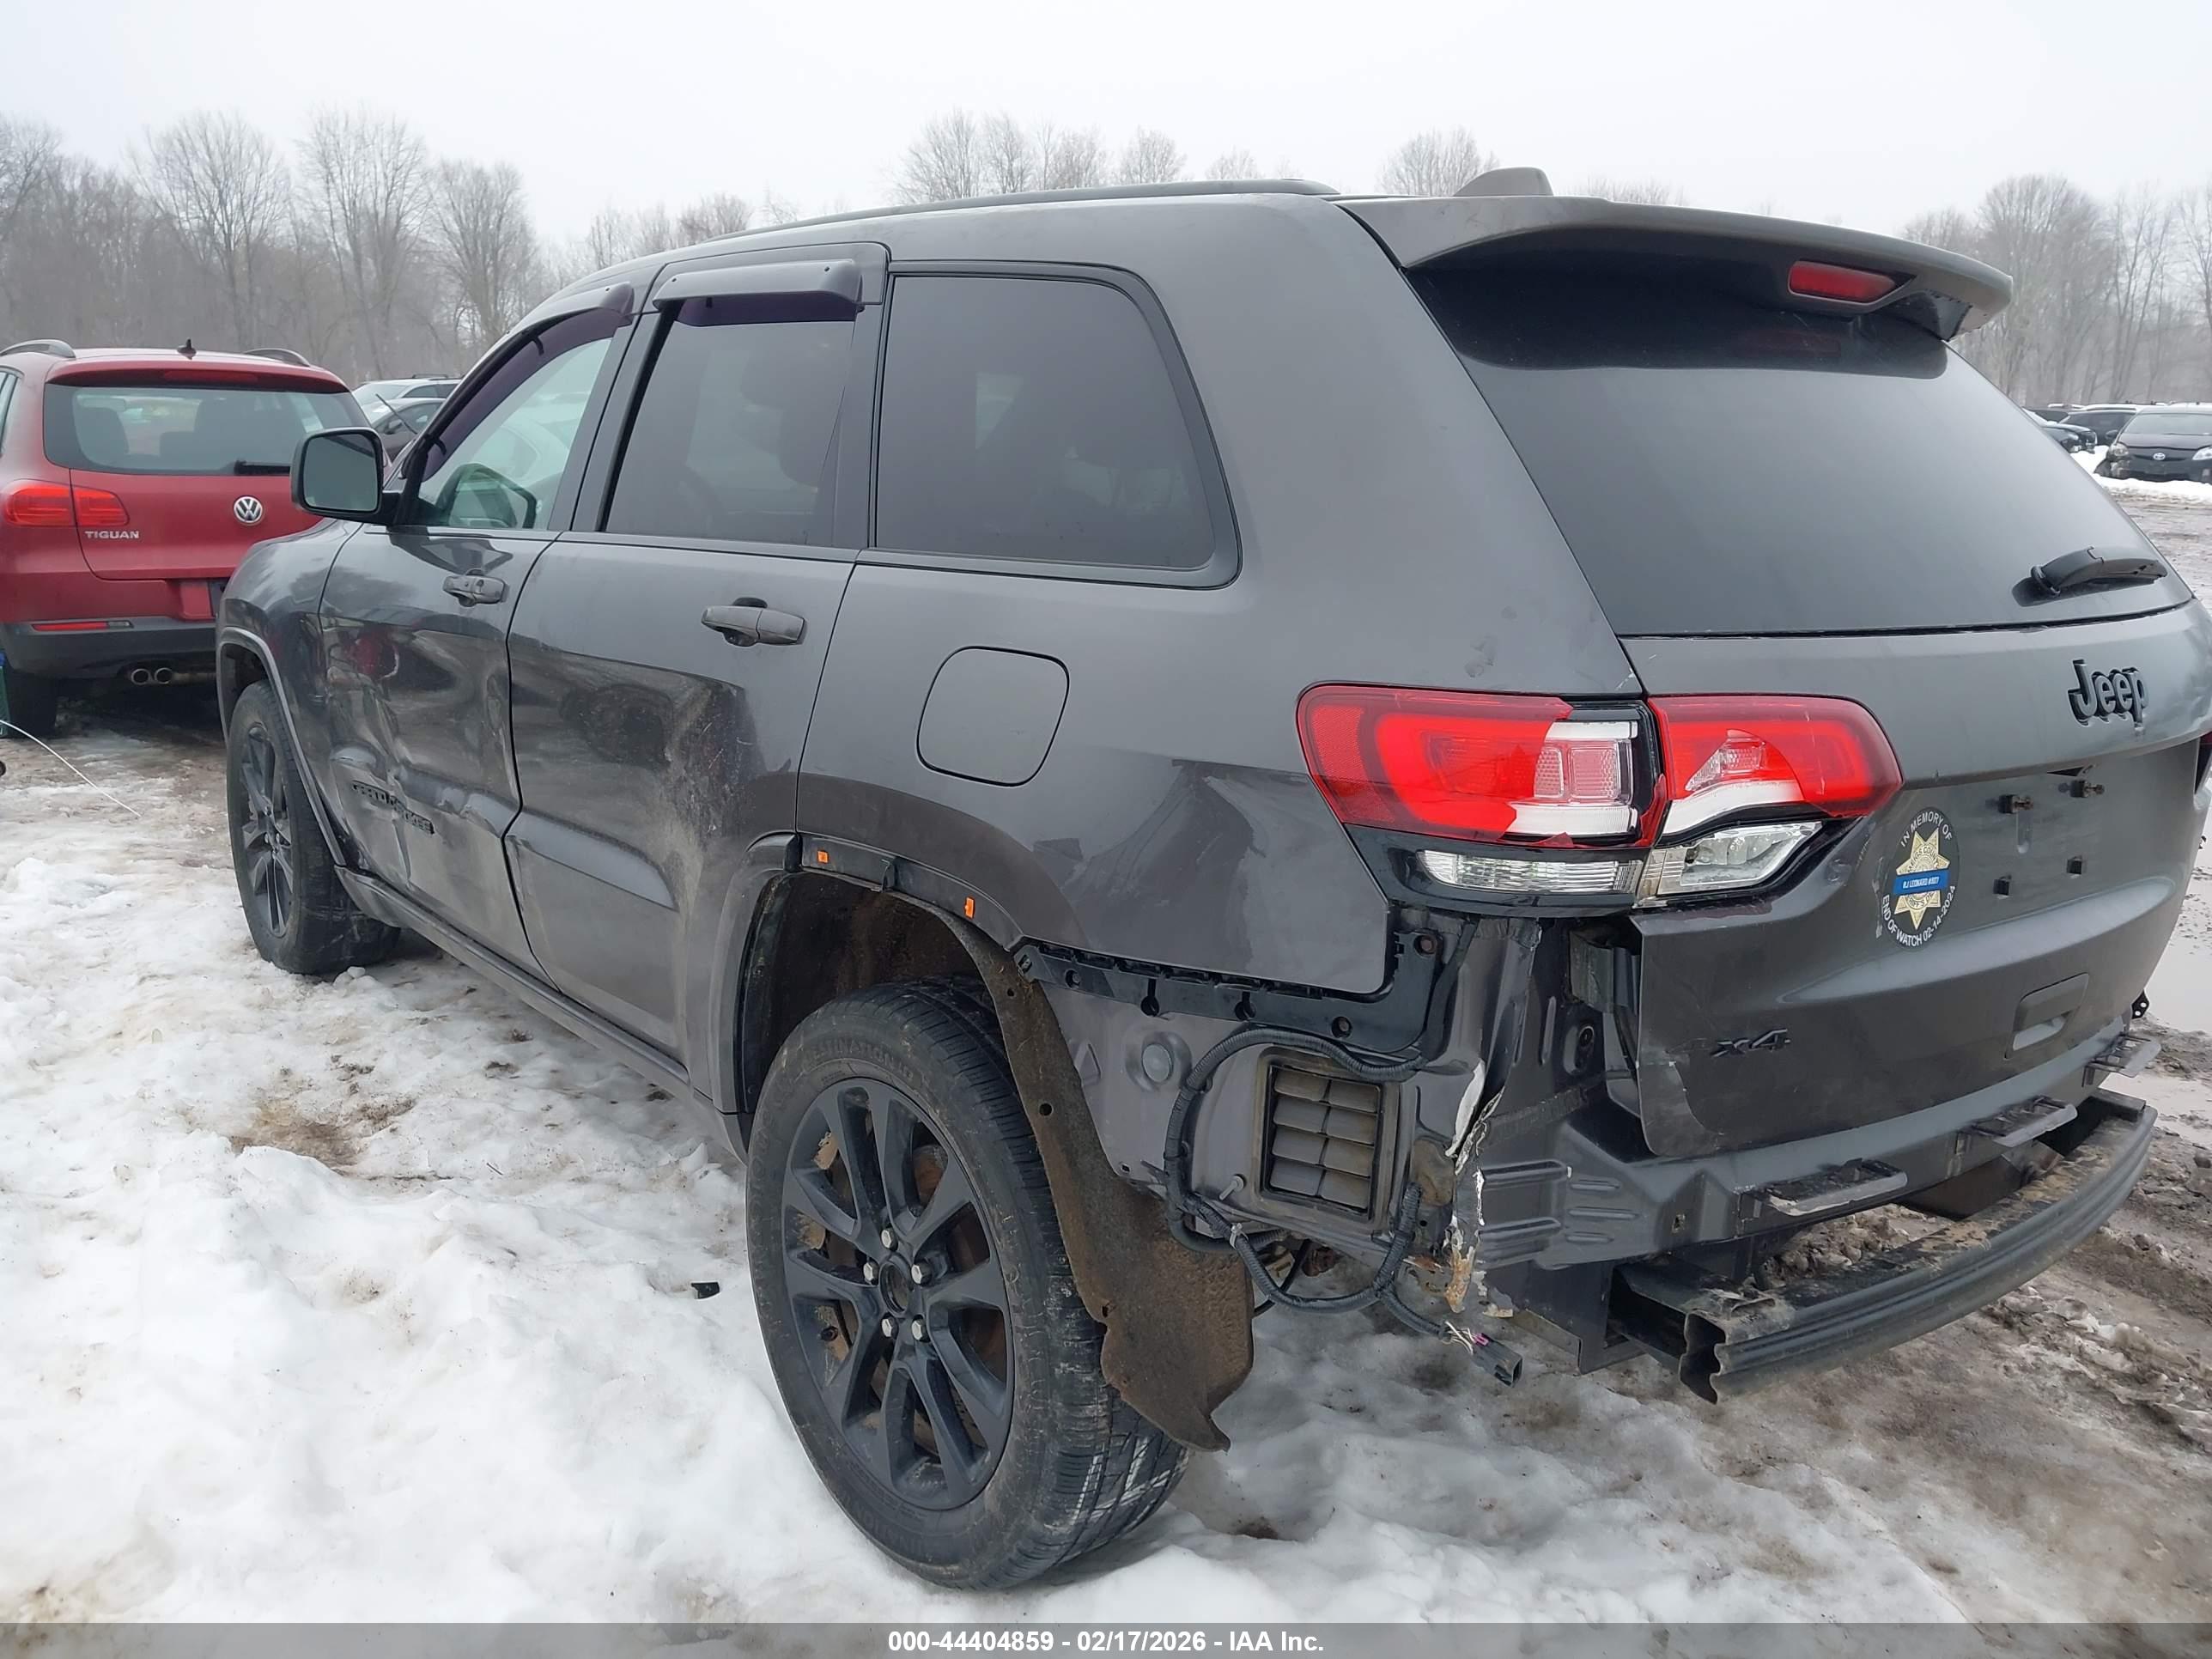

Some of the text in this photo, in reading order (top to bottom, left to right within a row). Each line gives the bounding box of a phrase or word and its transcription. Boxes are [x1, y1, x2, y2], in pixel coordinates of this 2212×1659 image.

[85, 530, 139, 539] TIGUAN
[2068, 659, 2149, 730] Jeep
[1900, 811, 1954, 848] IN MEMORY OF
[1881, 885, 1956, 947] END OF WATCH 02-14-2024
